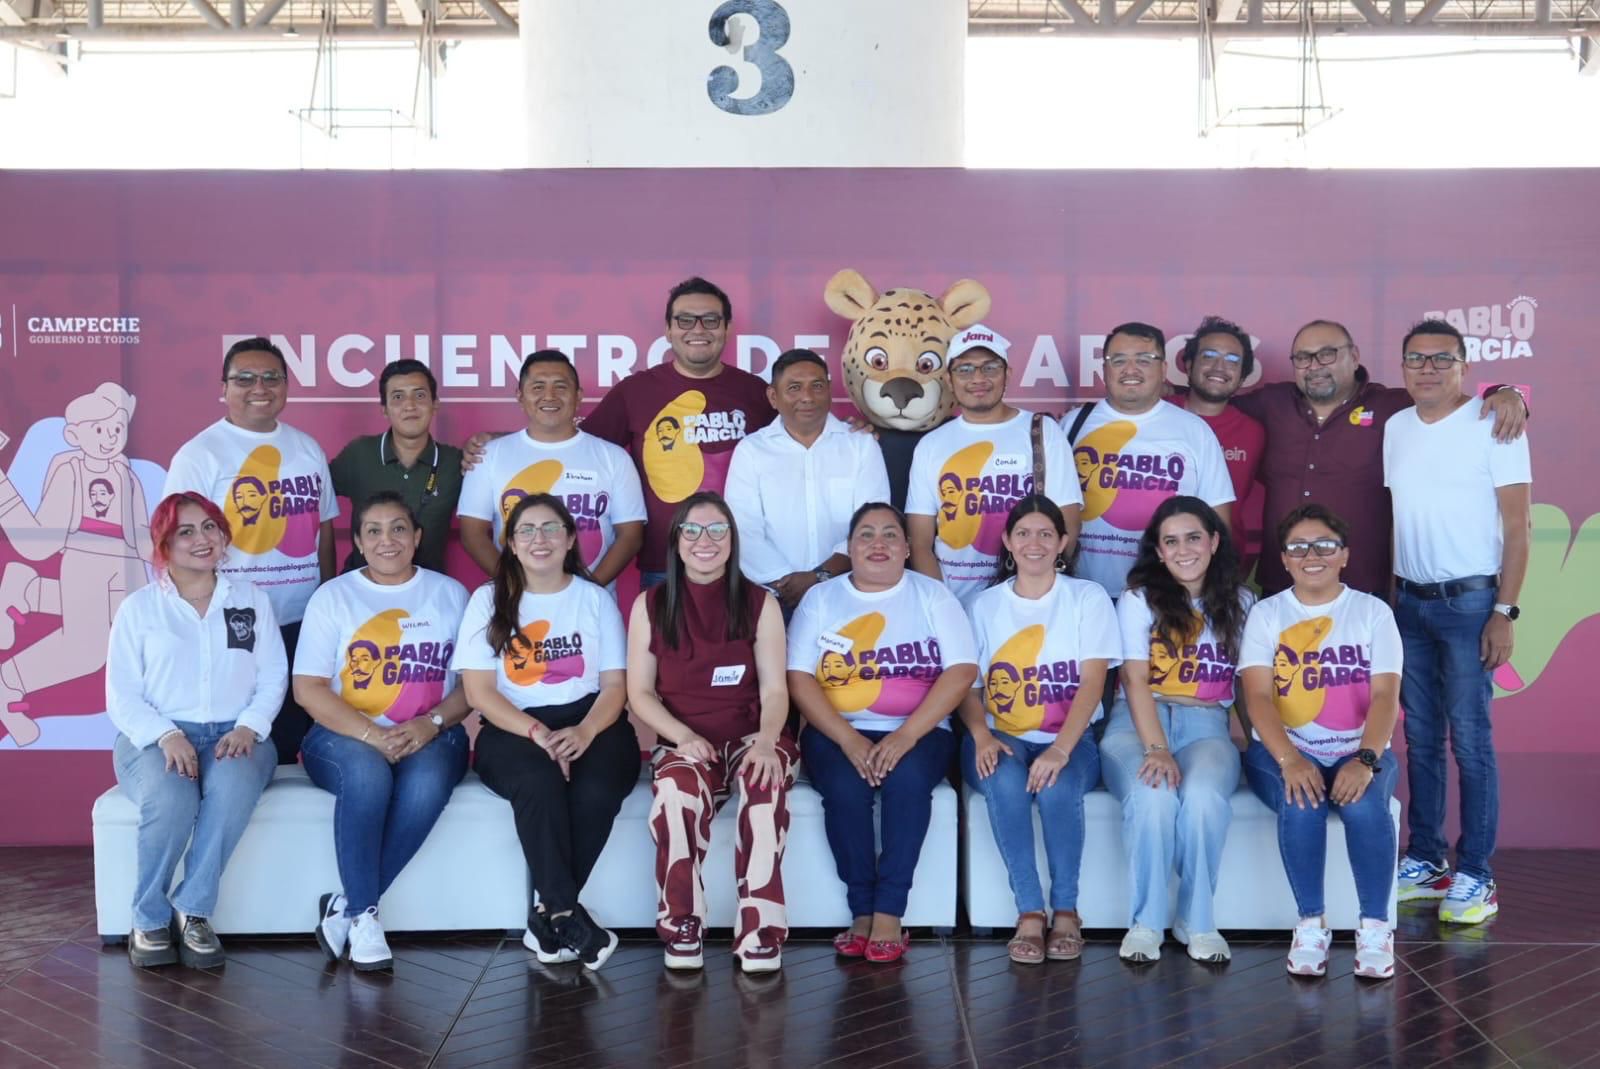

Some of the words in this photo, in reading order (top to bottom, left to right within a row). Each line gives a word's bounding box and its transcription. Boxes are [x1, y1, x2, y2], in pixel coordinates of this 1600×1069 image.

[707, 0, 795, 116] 3
[27, 317, 140, 333] CAMPECHE
[29, 335, 85, 344] GOBIERNO
[87, 335, 101, 344] DE
[104, 335, 140, 344] TODOS
[1463, 333, 1533, 363] RCÍA
[683, 411, 746, 430] PABLO
[1103, 453, 1184, 480] PABLO
[556, 494, 607, 518] BLO
[965, 493, 1018, 515] GARC
[534, 632, 583, 649] PABLO
[859, 640, 941, 664] PABLO
[384, 642, 454, 669] PABLO
[1303, 644, 1371, 668] PABL
[1022, 659, 1080, 683] PABL
[1024, 683, 1079, 707] GARC
